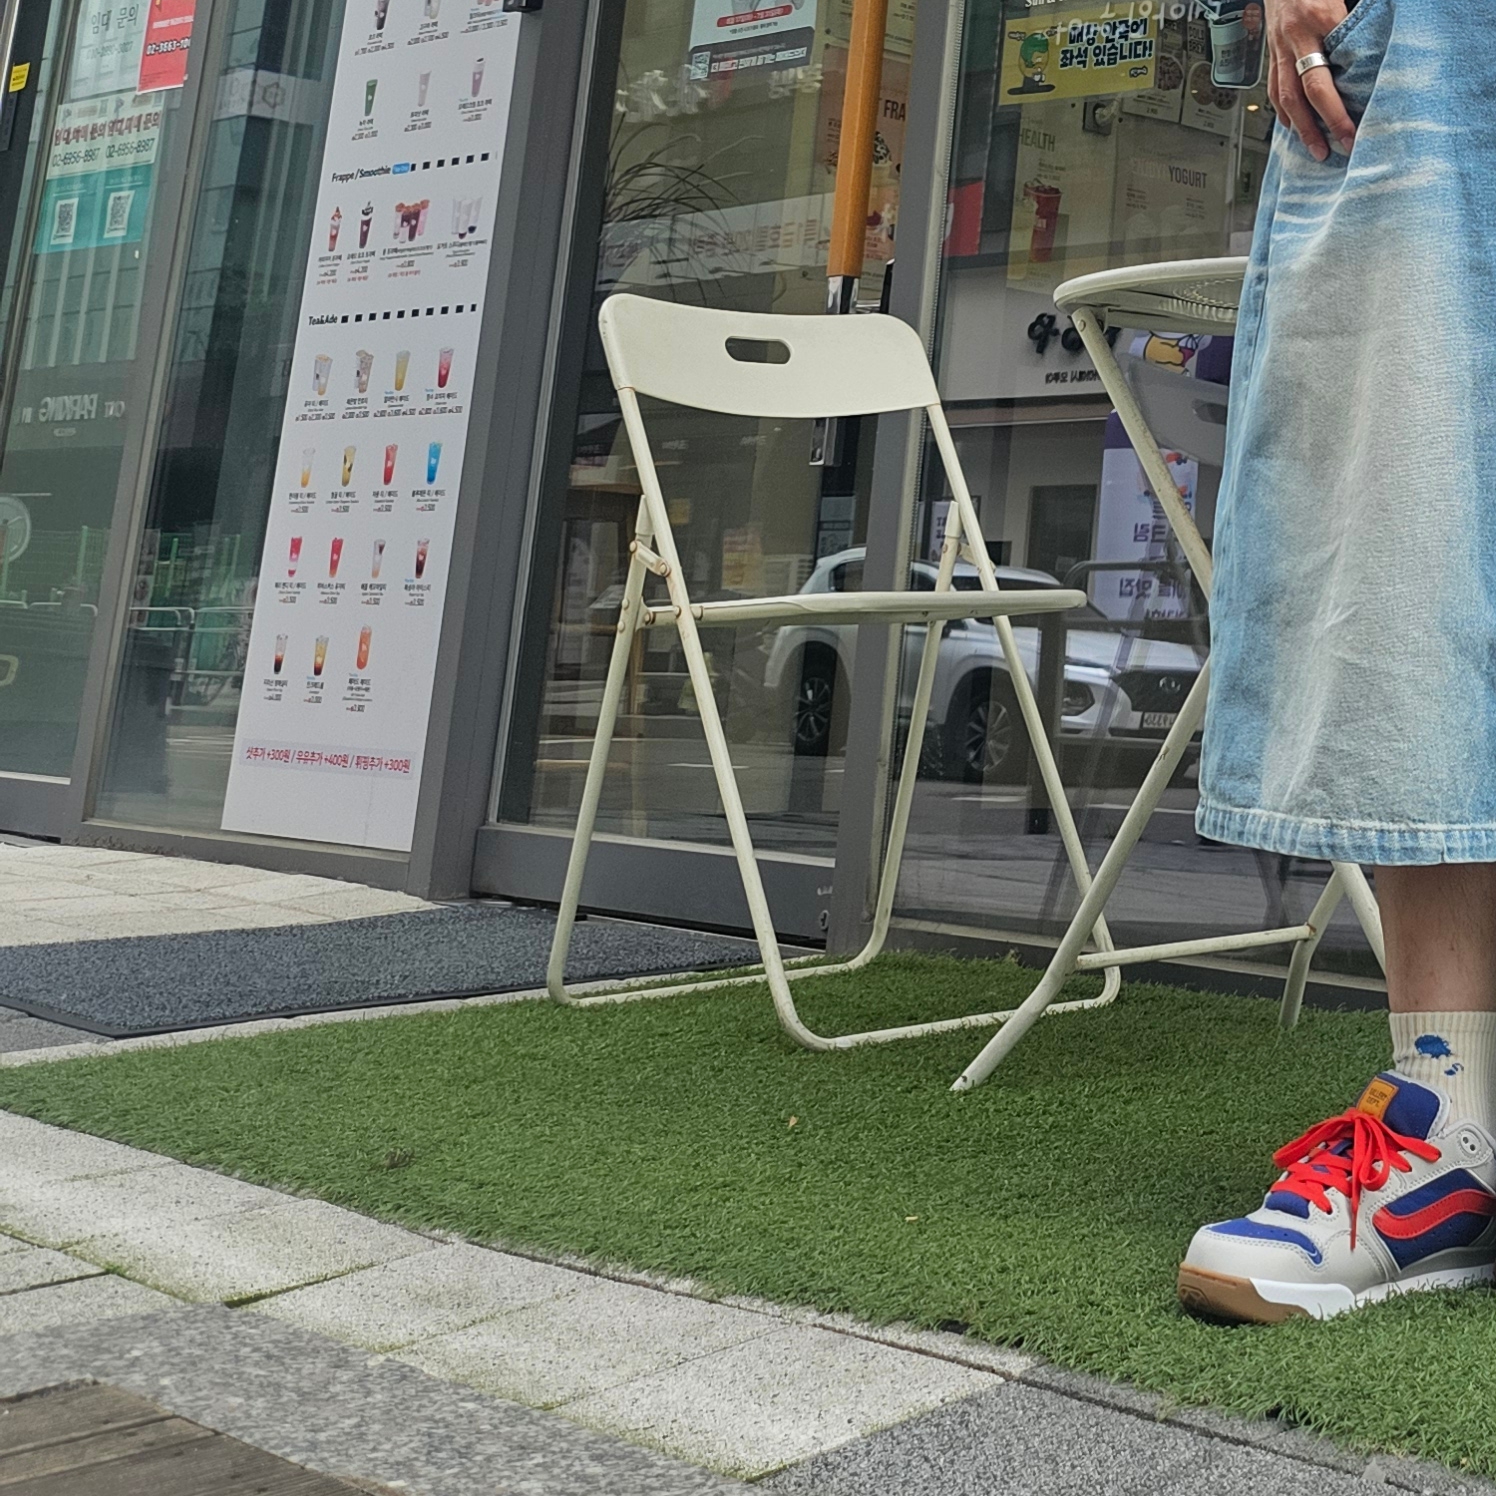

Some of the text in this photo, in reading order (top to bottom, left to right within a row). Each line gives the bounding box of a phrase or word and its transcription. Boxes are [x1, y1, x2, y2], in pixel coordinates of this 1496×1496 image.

[91, 9, 113, 35] 임대
[116, 3, 140, 30] 문의
[1068, 21, 1098, 45] 매장
[1059, 41, 1154, 70] 좌석 있습니다!
[1019, 127, 1056, 152] HEALTH
[1167, 165, 1208, 189] YOGURT
